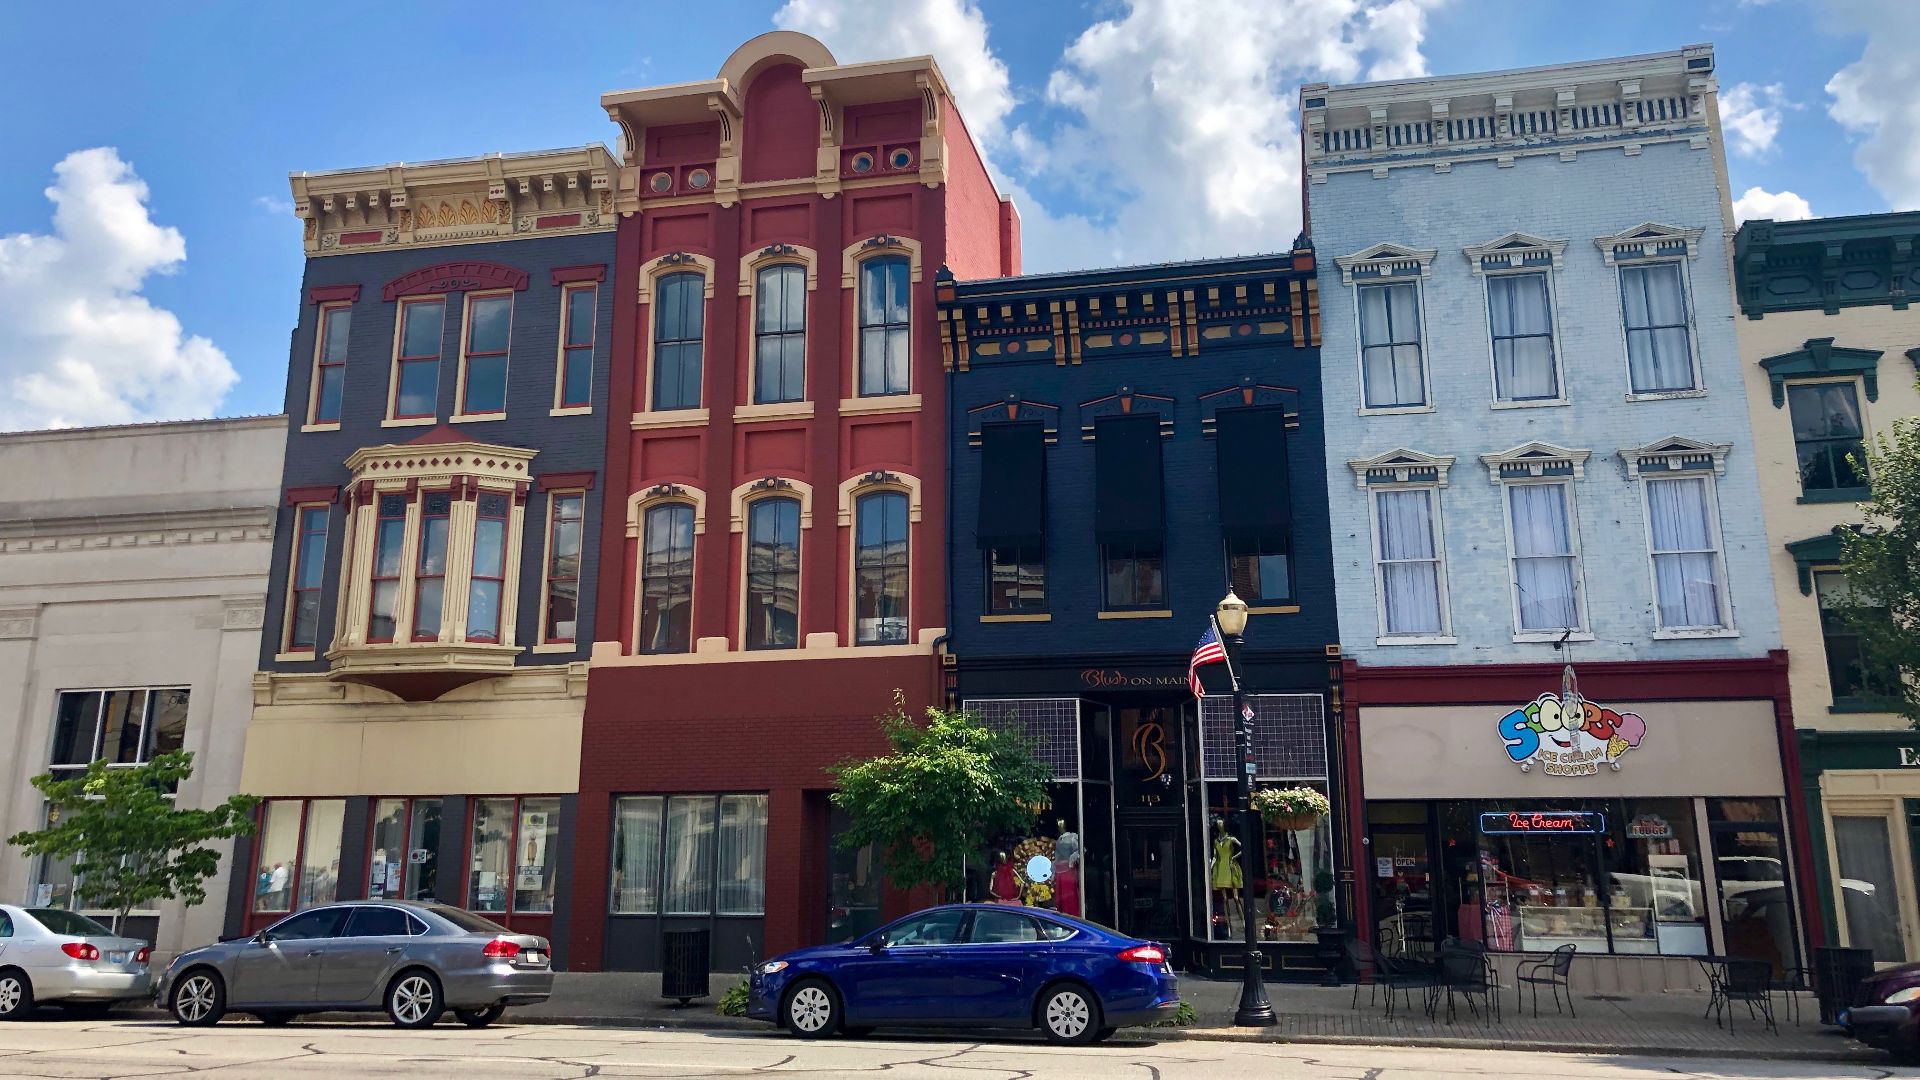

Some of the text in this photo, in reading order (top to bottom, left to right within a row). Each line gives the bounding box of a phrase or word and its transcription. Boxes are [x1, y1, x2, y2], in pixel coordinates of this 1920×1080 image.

[1081, 669, 1127, 688] Blush
[1131, 677, 1152, 686] ON
[1538, 748, 1558, 763] ICE
[1545, 762, 1597, 775] SHOPPE
[1509, 813, 1574, 831] Ice Cream
[1396, 858, 1415, 866] OPEN
